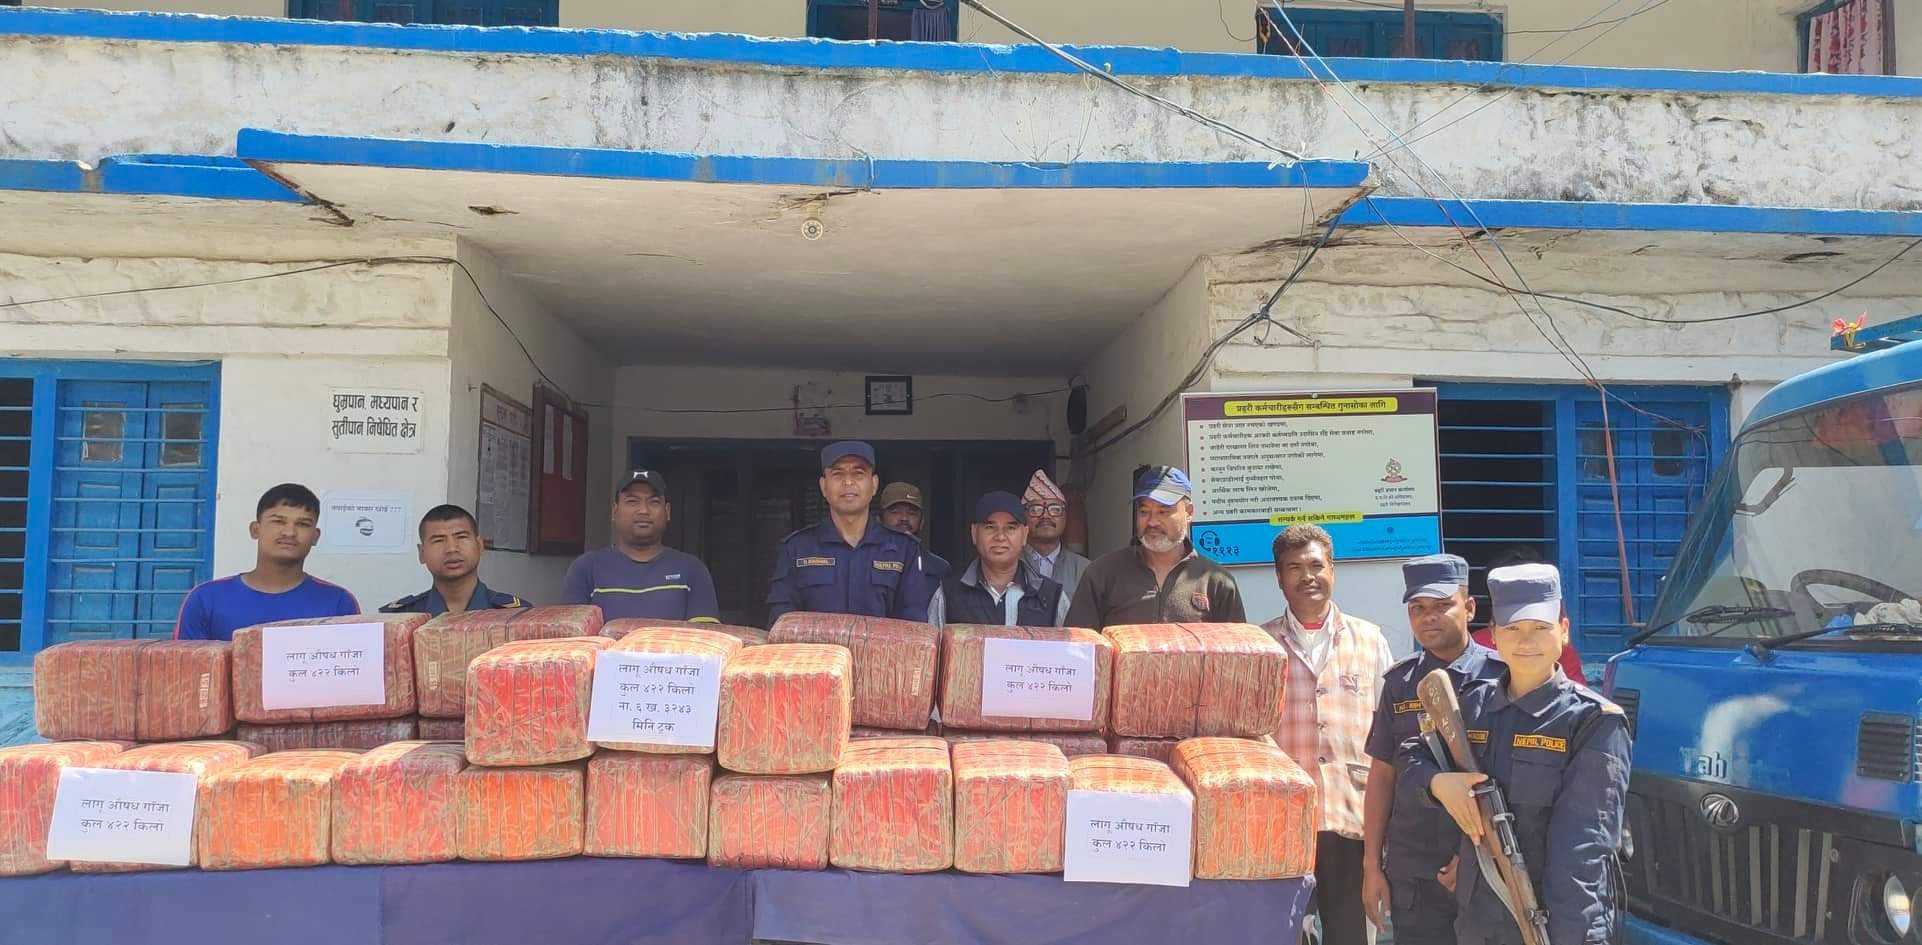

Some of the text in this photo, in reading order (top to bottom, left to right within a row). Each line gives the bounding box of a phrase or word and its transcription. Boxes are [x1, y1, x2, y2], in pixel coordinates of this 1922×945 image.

[412, 397, 419, 412] र
[400, 418, 416, 438] क्षेत्र
[288, 665, 360, 682] कुल ४२२ किलो
[619, 682, 695, 696] कुल ४२२ किलो
[1007, 680, 1072, 693] कुल ४२२ किलो
[664, 703, 692, 715] ३२४३
[632, 718, 655, 732] मिनि
[81, 818, 164, 832] कुल ४२२ किलो
[1092, 838, 1166, 852] कुल ४२२ किलो
